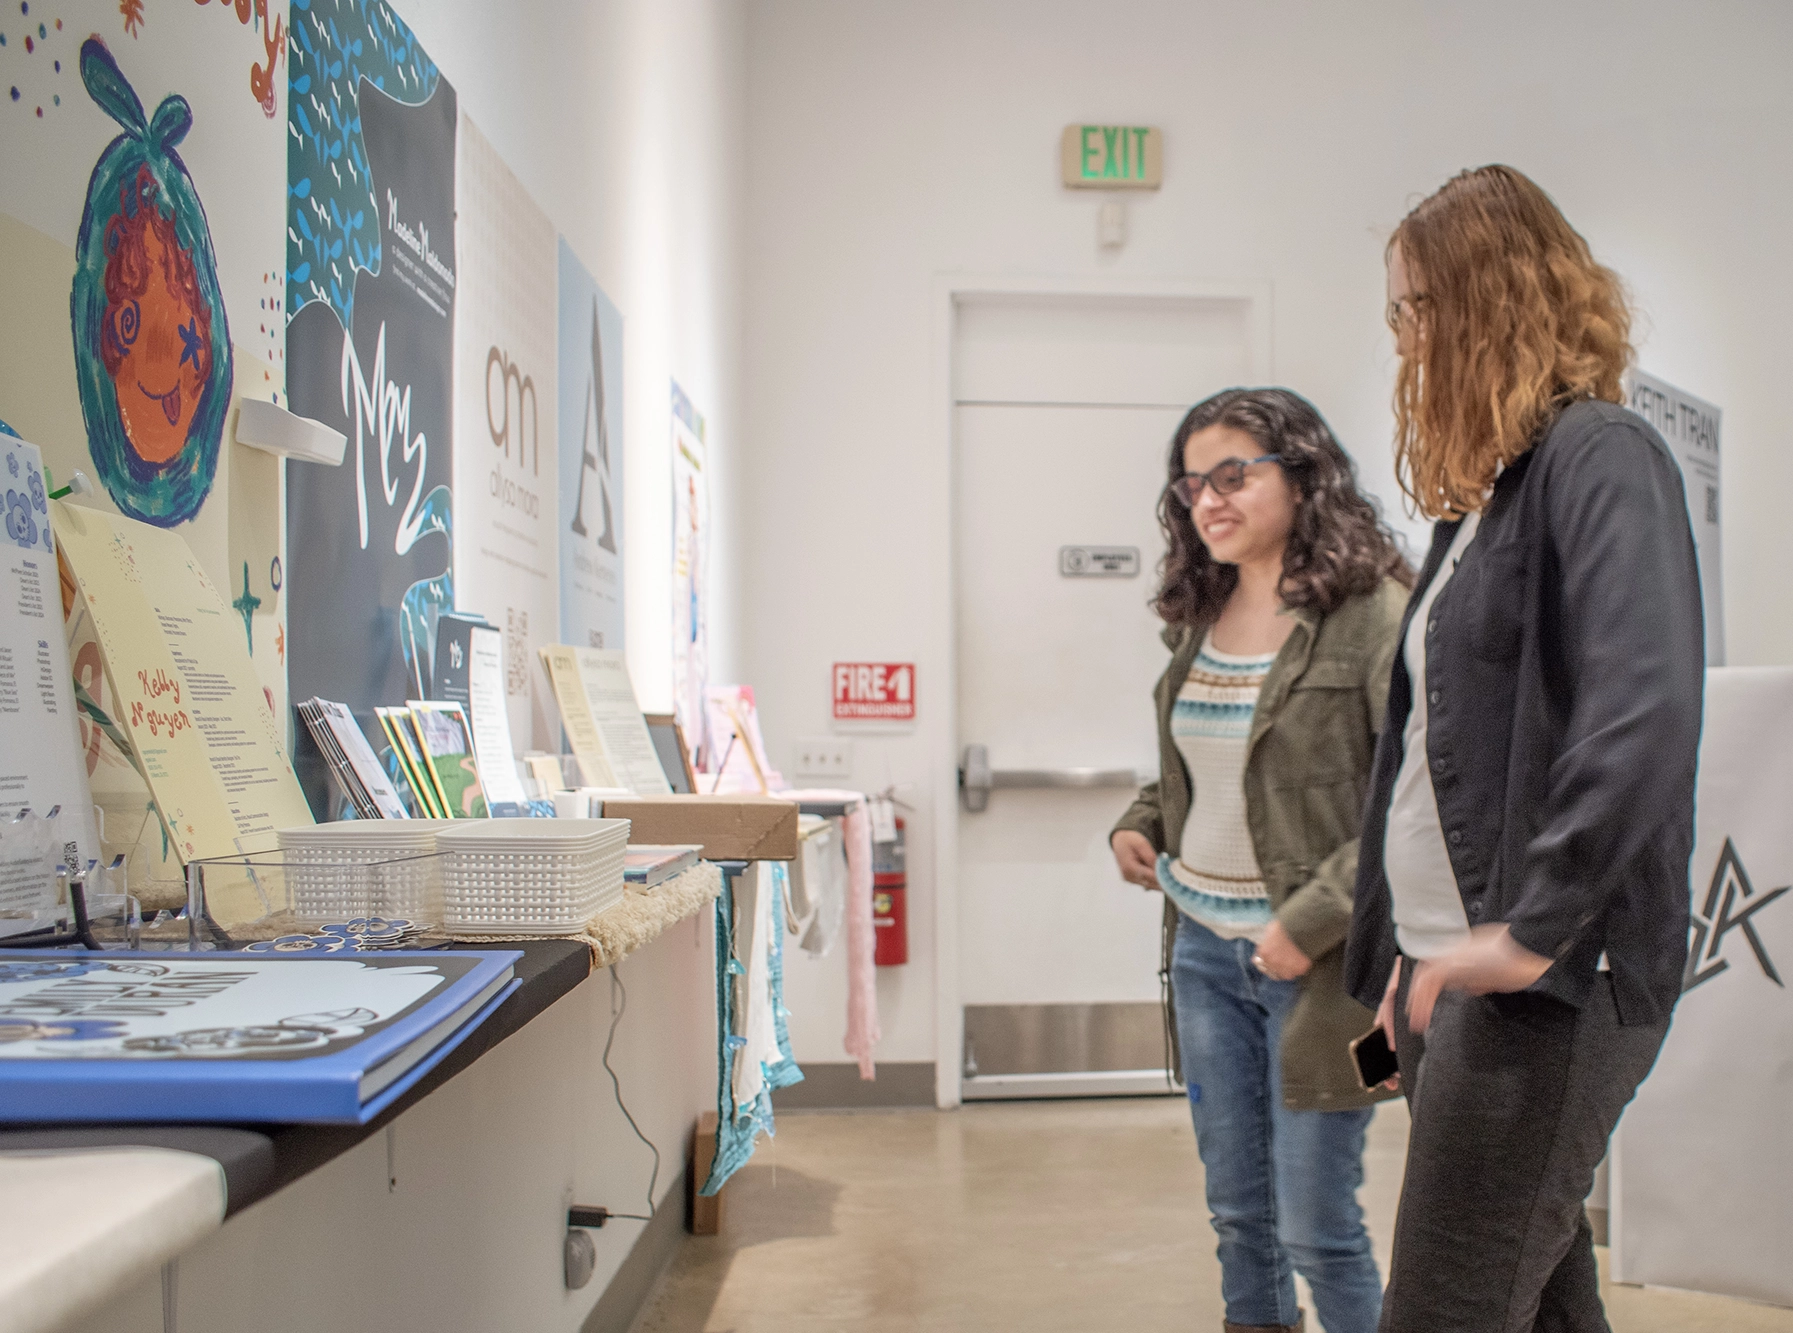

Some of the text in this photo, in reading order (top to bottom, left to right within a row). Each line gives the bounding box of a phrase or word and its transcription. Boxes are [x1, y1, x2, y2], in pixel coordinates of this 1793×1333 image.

[1081, 125, 1149, 179] EXIT
[1632, 379, 1719, 452] KEITH TRAN
[836, 666, 886, 700] FIRE
[837, 702, 912, 716] EXTINGUISHER
[0, 978, 150, 1017] EMILY
[65, 971, 259, 1017] DURAN
